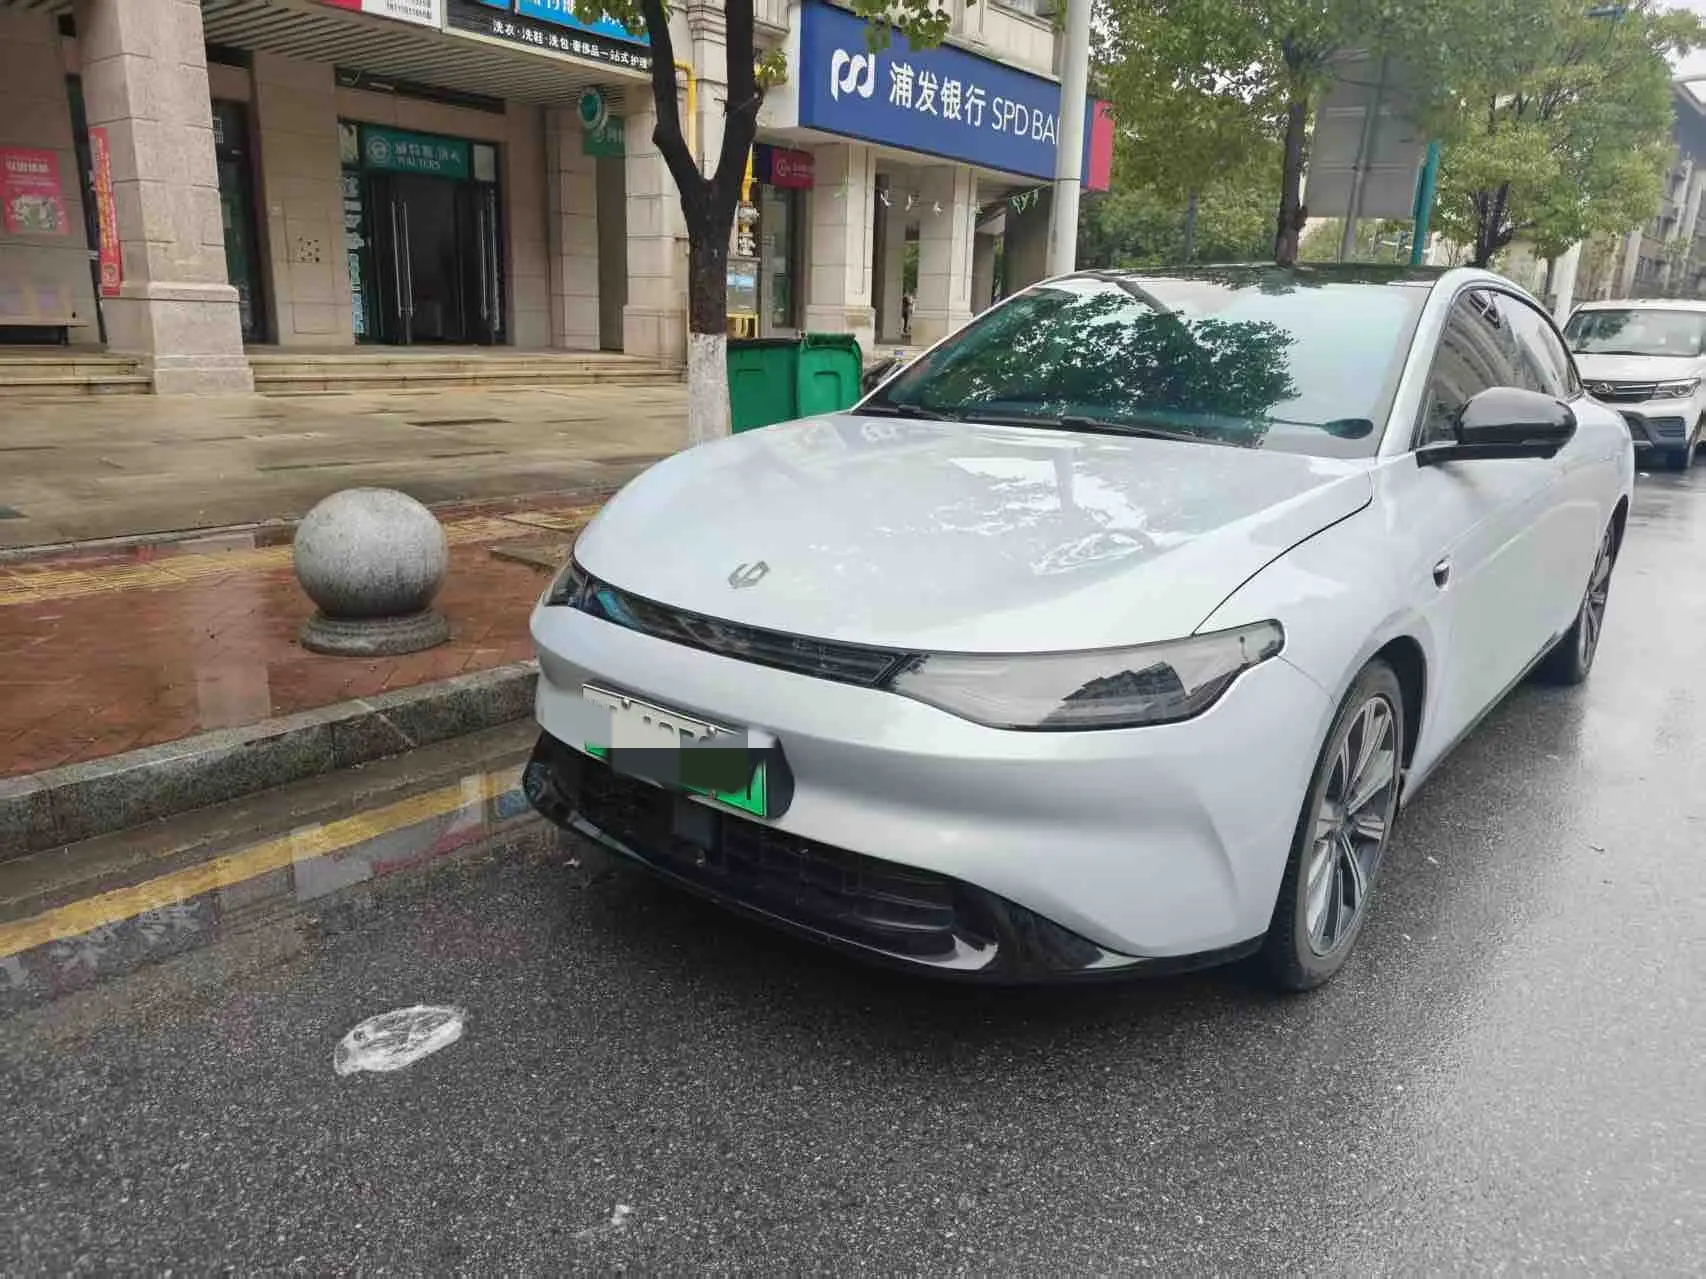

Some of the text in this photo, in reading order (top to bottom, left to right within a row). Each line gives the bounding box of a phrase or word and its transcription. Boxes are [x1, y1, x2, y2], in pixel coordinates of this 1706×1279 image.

[889, 61, 987, 127] 浦发银行
[991, 97, 1029, 136] SPD
